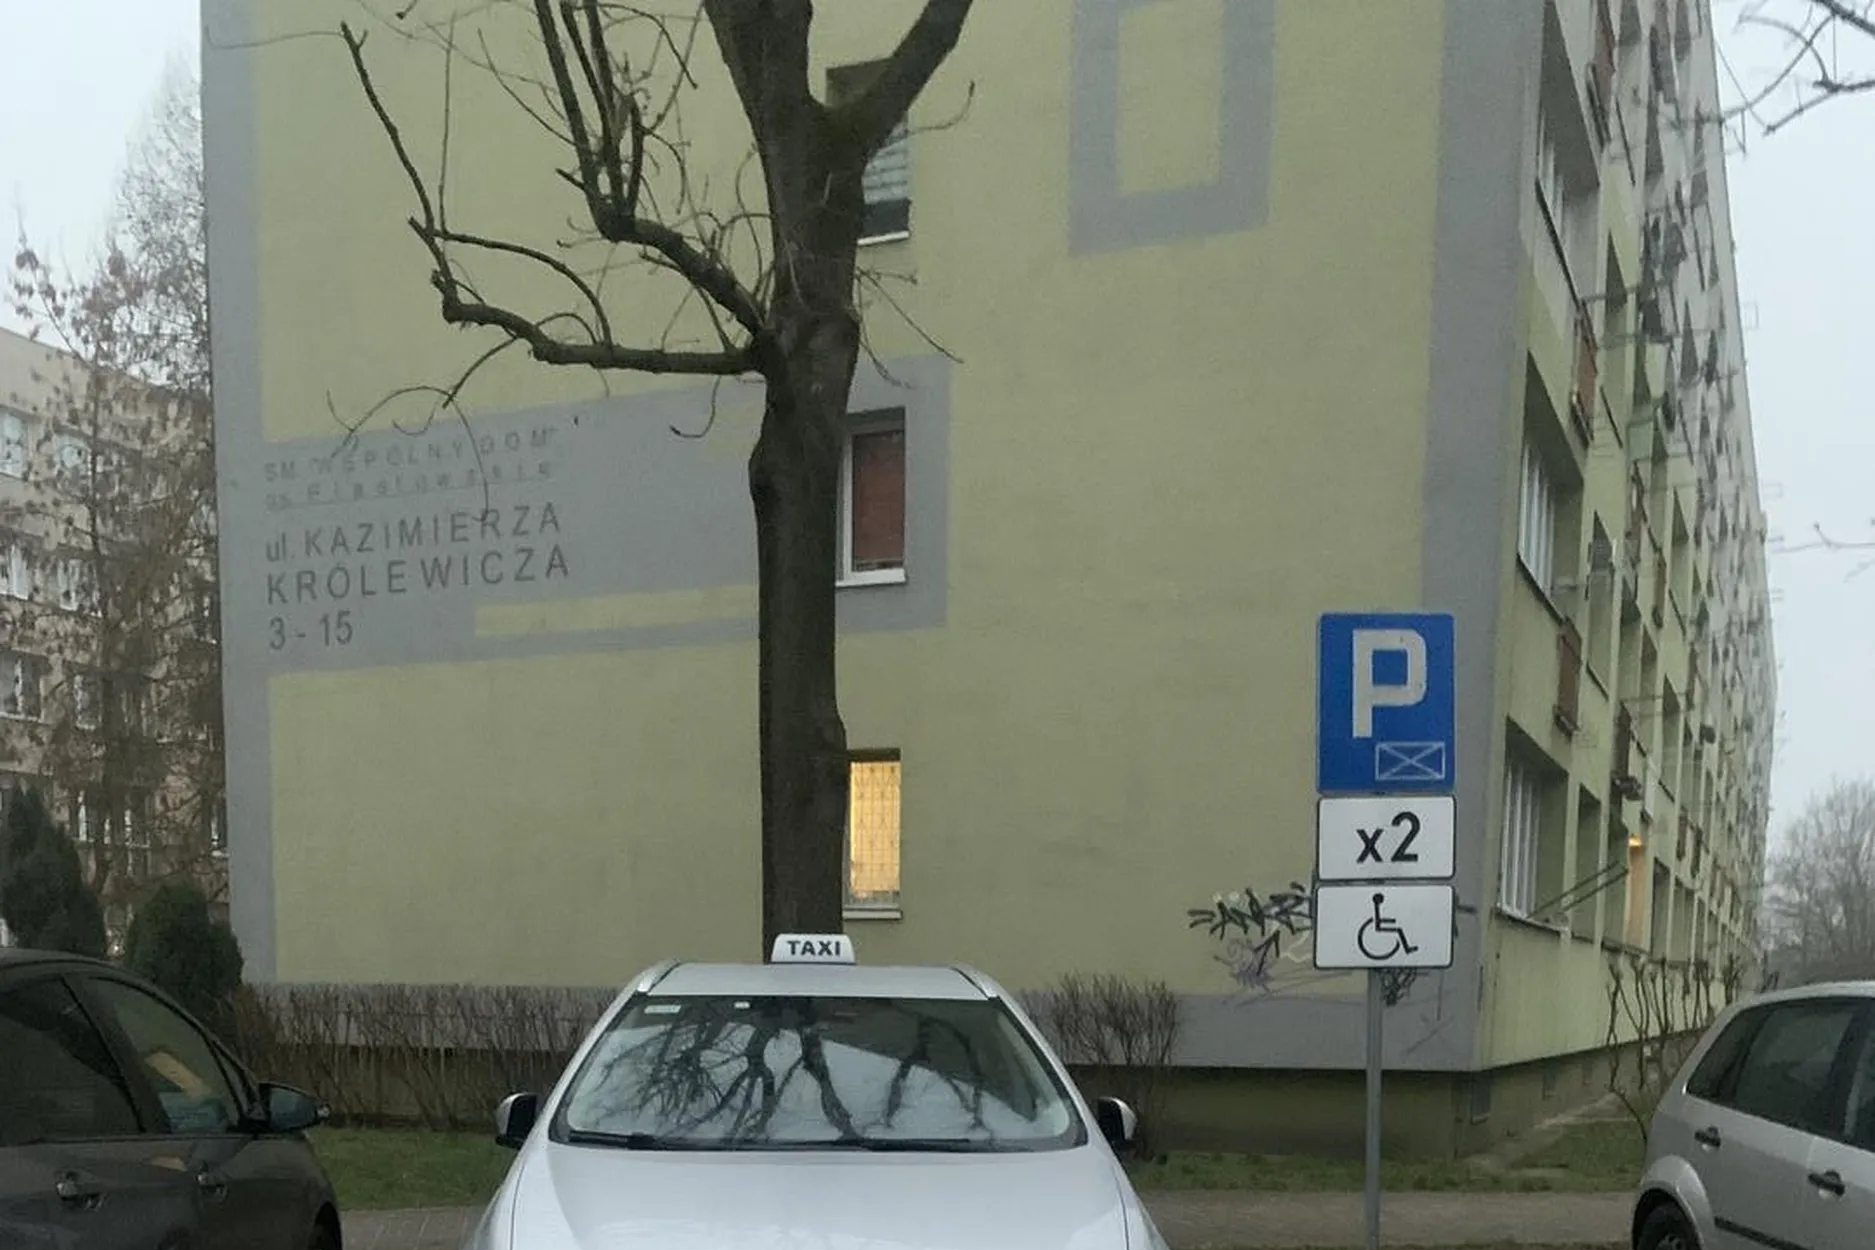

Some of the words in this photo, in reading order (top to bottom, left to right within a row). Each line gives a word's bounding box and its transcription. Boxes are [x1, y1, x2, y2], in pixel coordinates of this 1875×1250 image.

[304, 501, 561, 556] KAZIMIERZA
[266, 543, 569, 605] KRÓLEWICZA
[1352, 628, 1427, 738] P
[786, 940, 841, 957] TAXI
